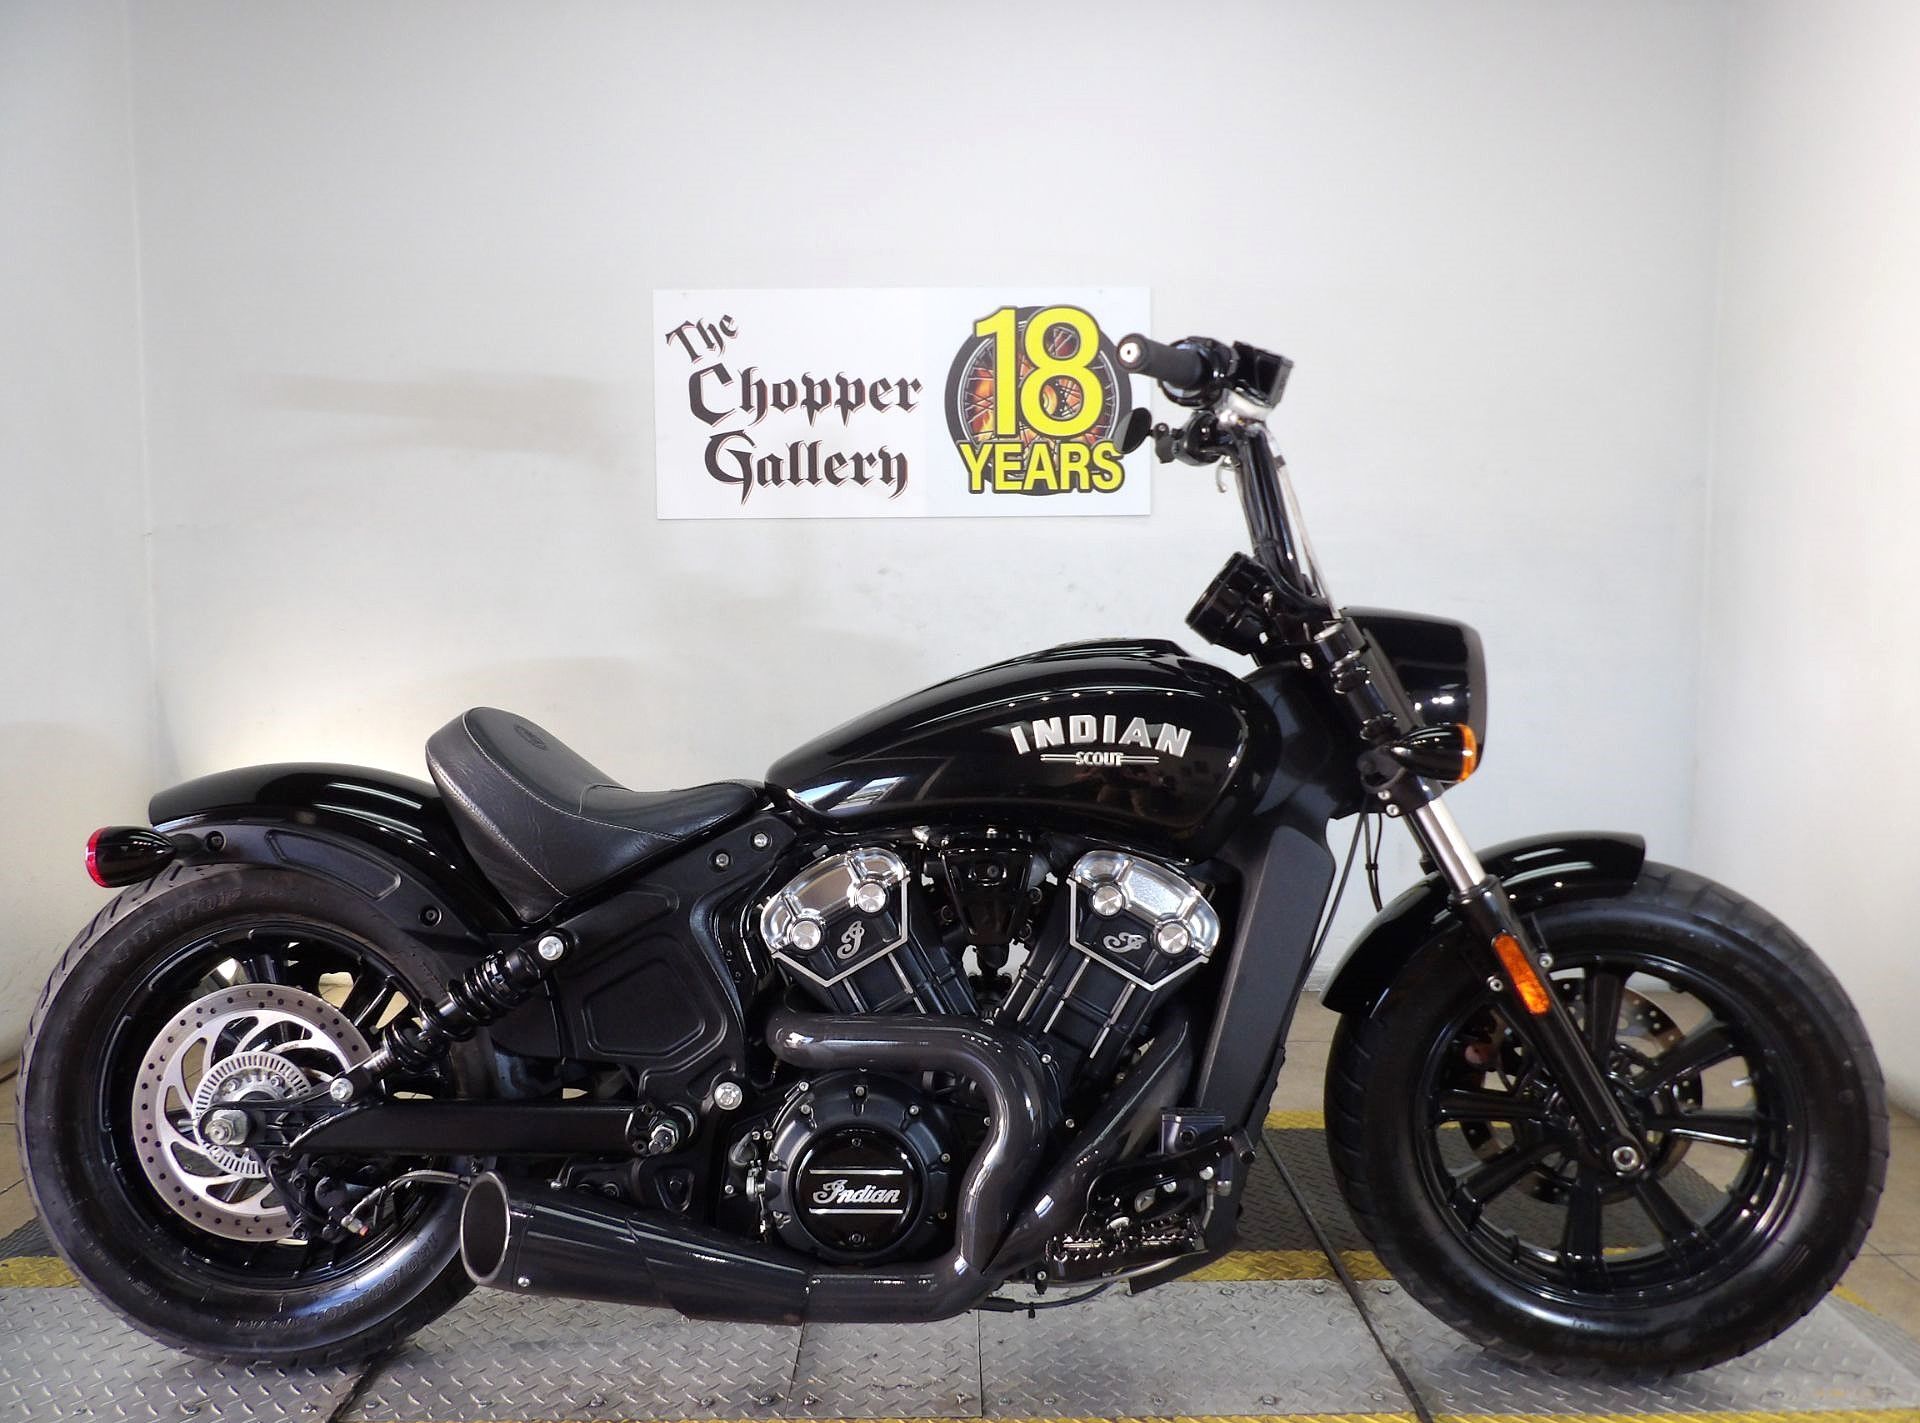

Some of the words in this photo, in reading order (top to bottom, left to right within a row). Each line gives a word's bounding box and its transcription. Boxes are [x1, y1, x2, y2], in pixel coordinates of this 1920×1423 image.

[665, 313, 738, 363] The
[689, 362, 922, 427] Chopper
[974, 306, 1104, 439] 18
[704, 429, 909, 505] Gallery
[957, 439, 1126, 494] YEARS
[1010, 714, 1192, 758] INDIAN
[1075, 751, 1124, 766] SCOUT
[812, 1179, 901, 1204] Indian
